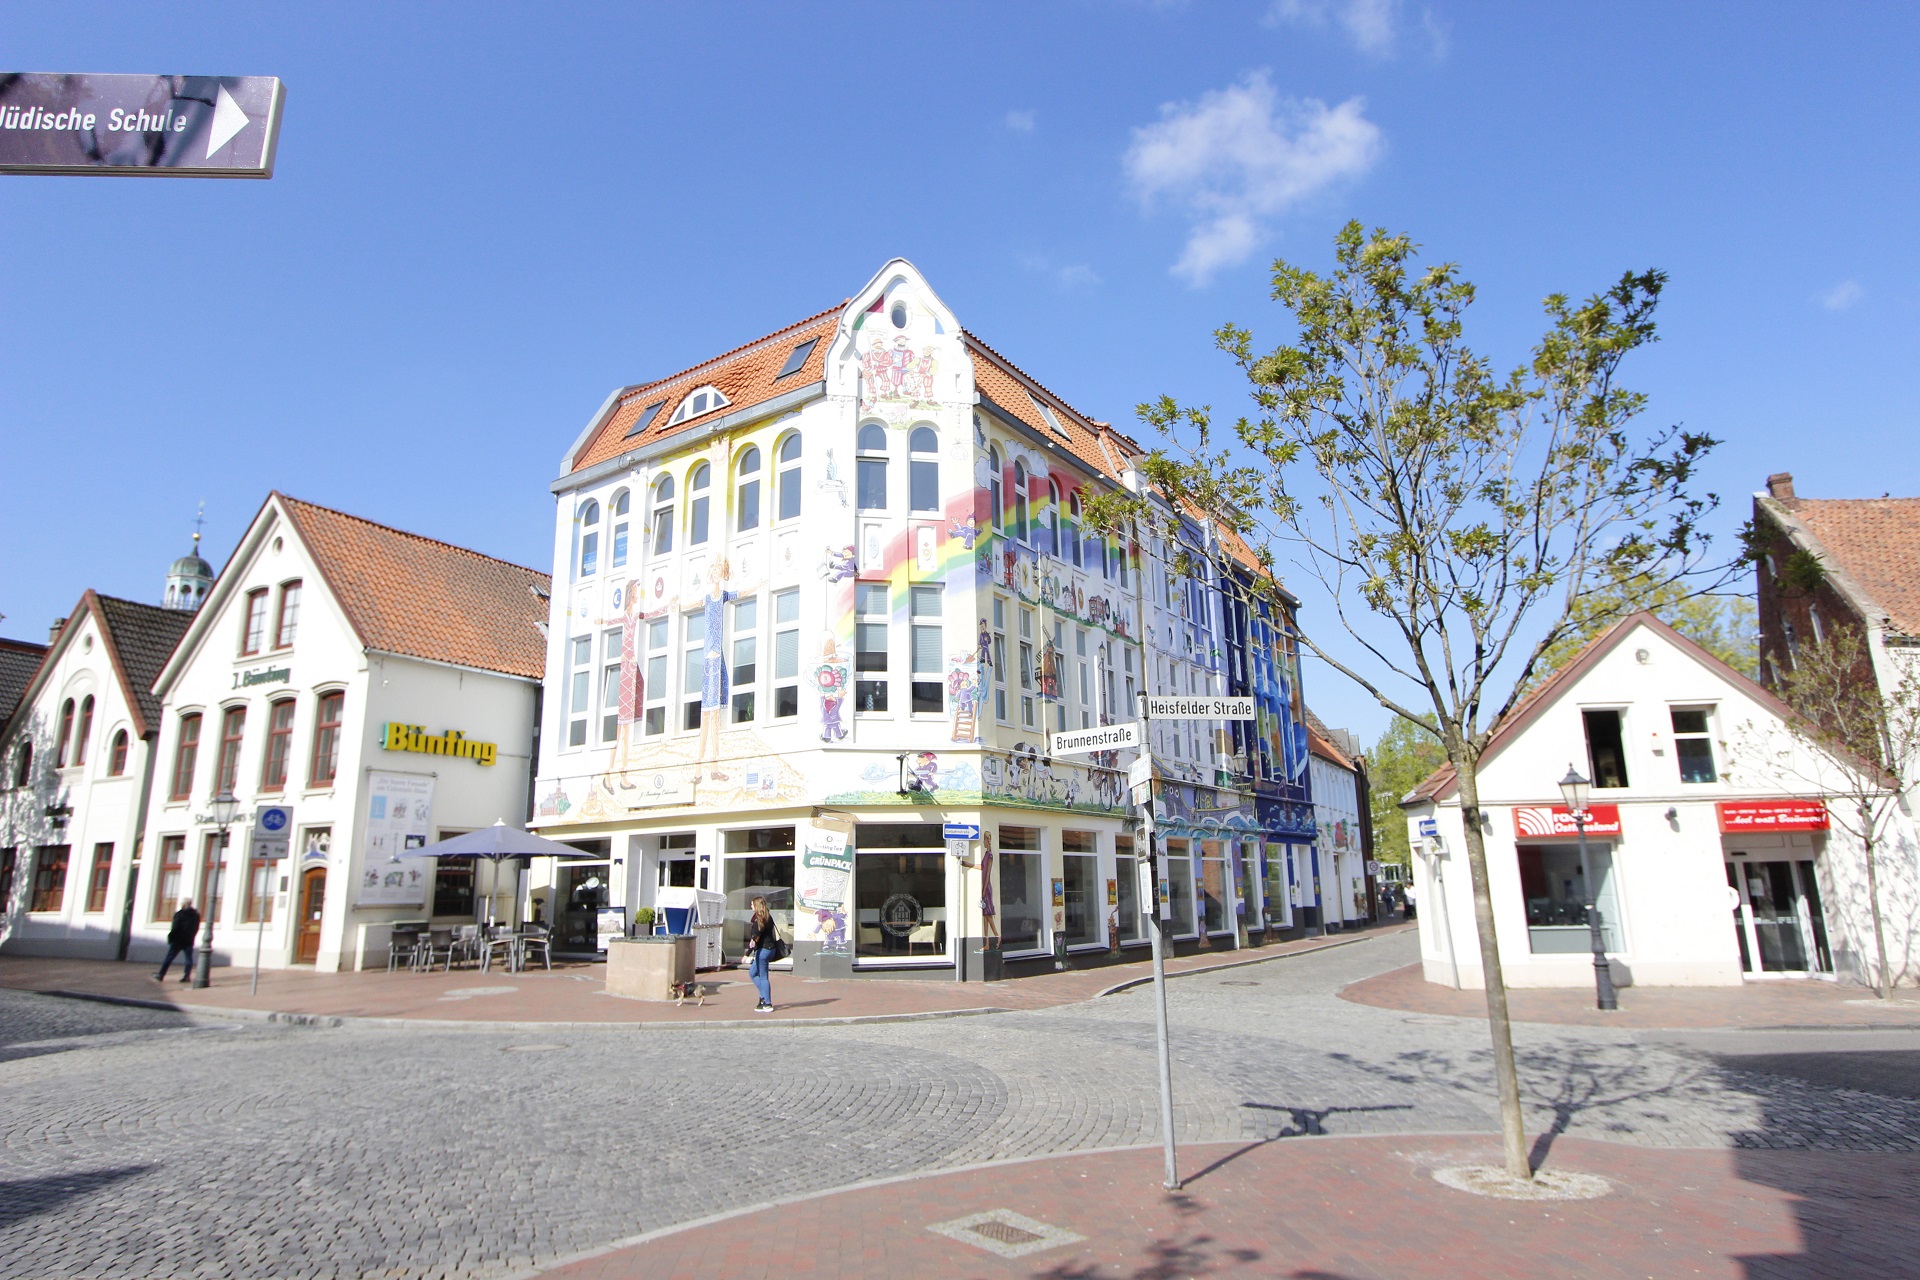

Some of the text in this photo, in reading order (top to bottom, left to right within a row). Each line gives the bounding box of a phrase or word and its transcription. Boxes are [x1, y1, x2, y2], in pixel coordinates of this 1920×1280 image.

[0, 105, 187, 132] Jüdische Schule
[243, 664, 291, 687] Bünting
[1151, 700, 1251, 715] Heisfelder Straße
[382, 721, 498, 767] Bünting
[1056, 727, 1132, 750] Brunnenstraße
[1555, 821, 1619, 832] Ostfesland
[809, 855, 852, 871] GRÜNPACK
